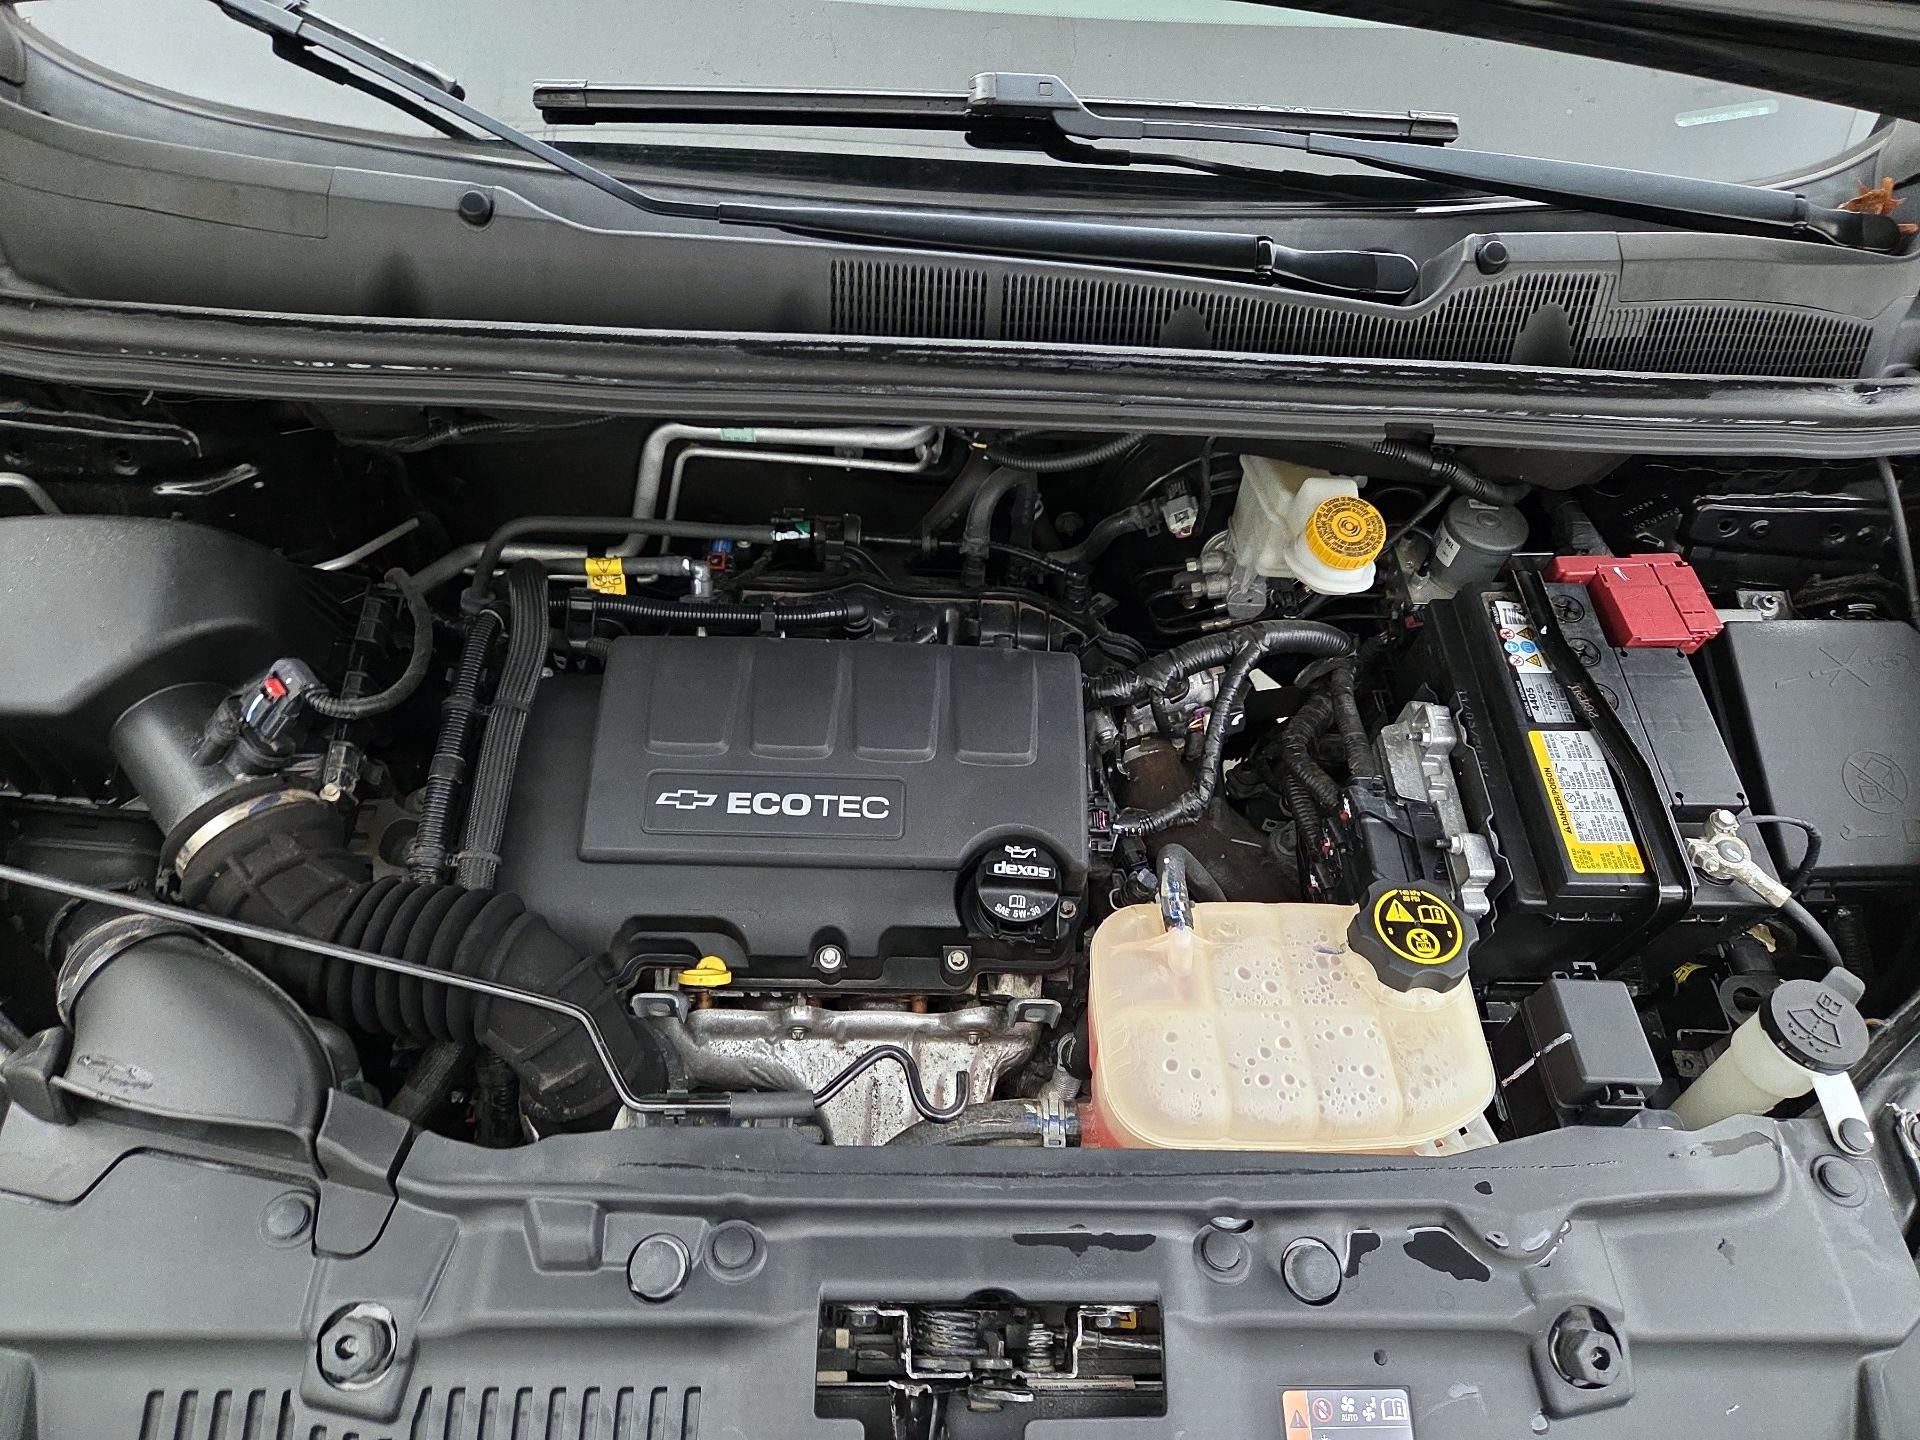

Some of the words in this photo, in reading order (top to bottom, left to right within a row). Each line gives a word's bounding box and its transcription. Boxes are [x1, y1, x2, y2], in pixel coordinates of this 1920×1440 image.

[1526, 687, 1540, 712] 4405
[727, 792, 890, 819] ECOTEC
[1543, 767, 1570, 824] DANGER/POISON
[993, 861, 1051, 878] dexos
[995, 904, 1010, 916] SAE
[1013, 906, 1041, 918] 5W-30
[1341, 1413, 1358, 1422] AUTO
